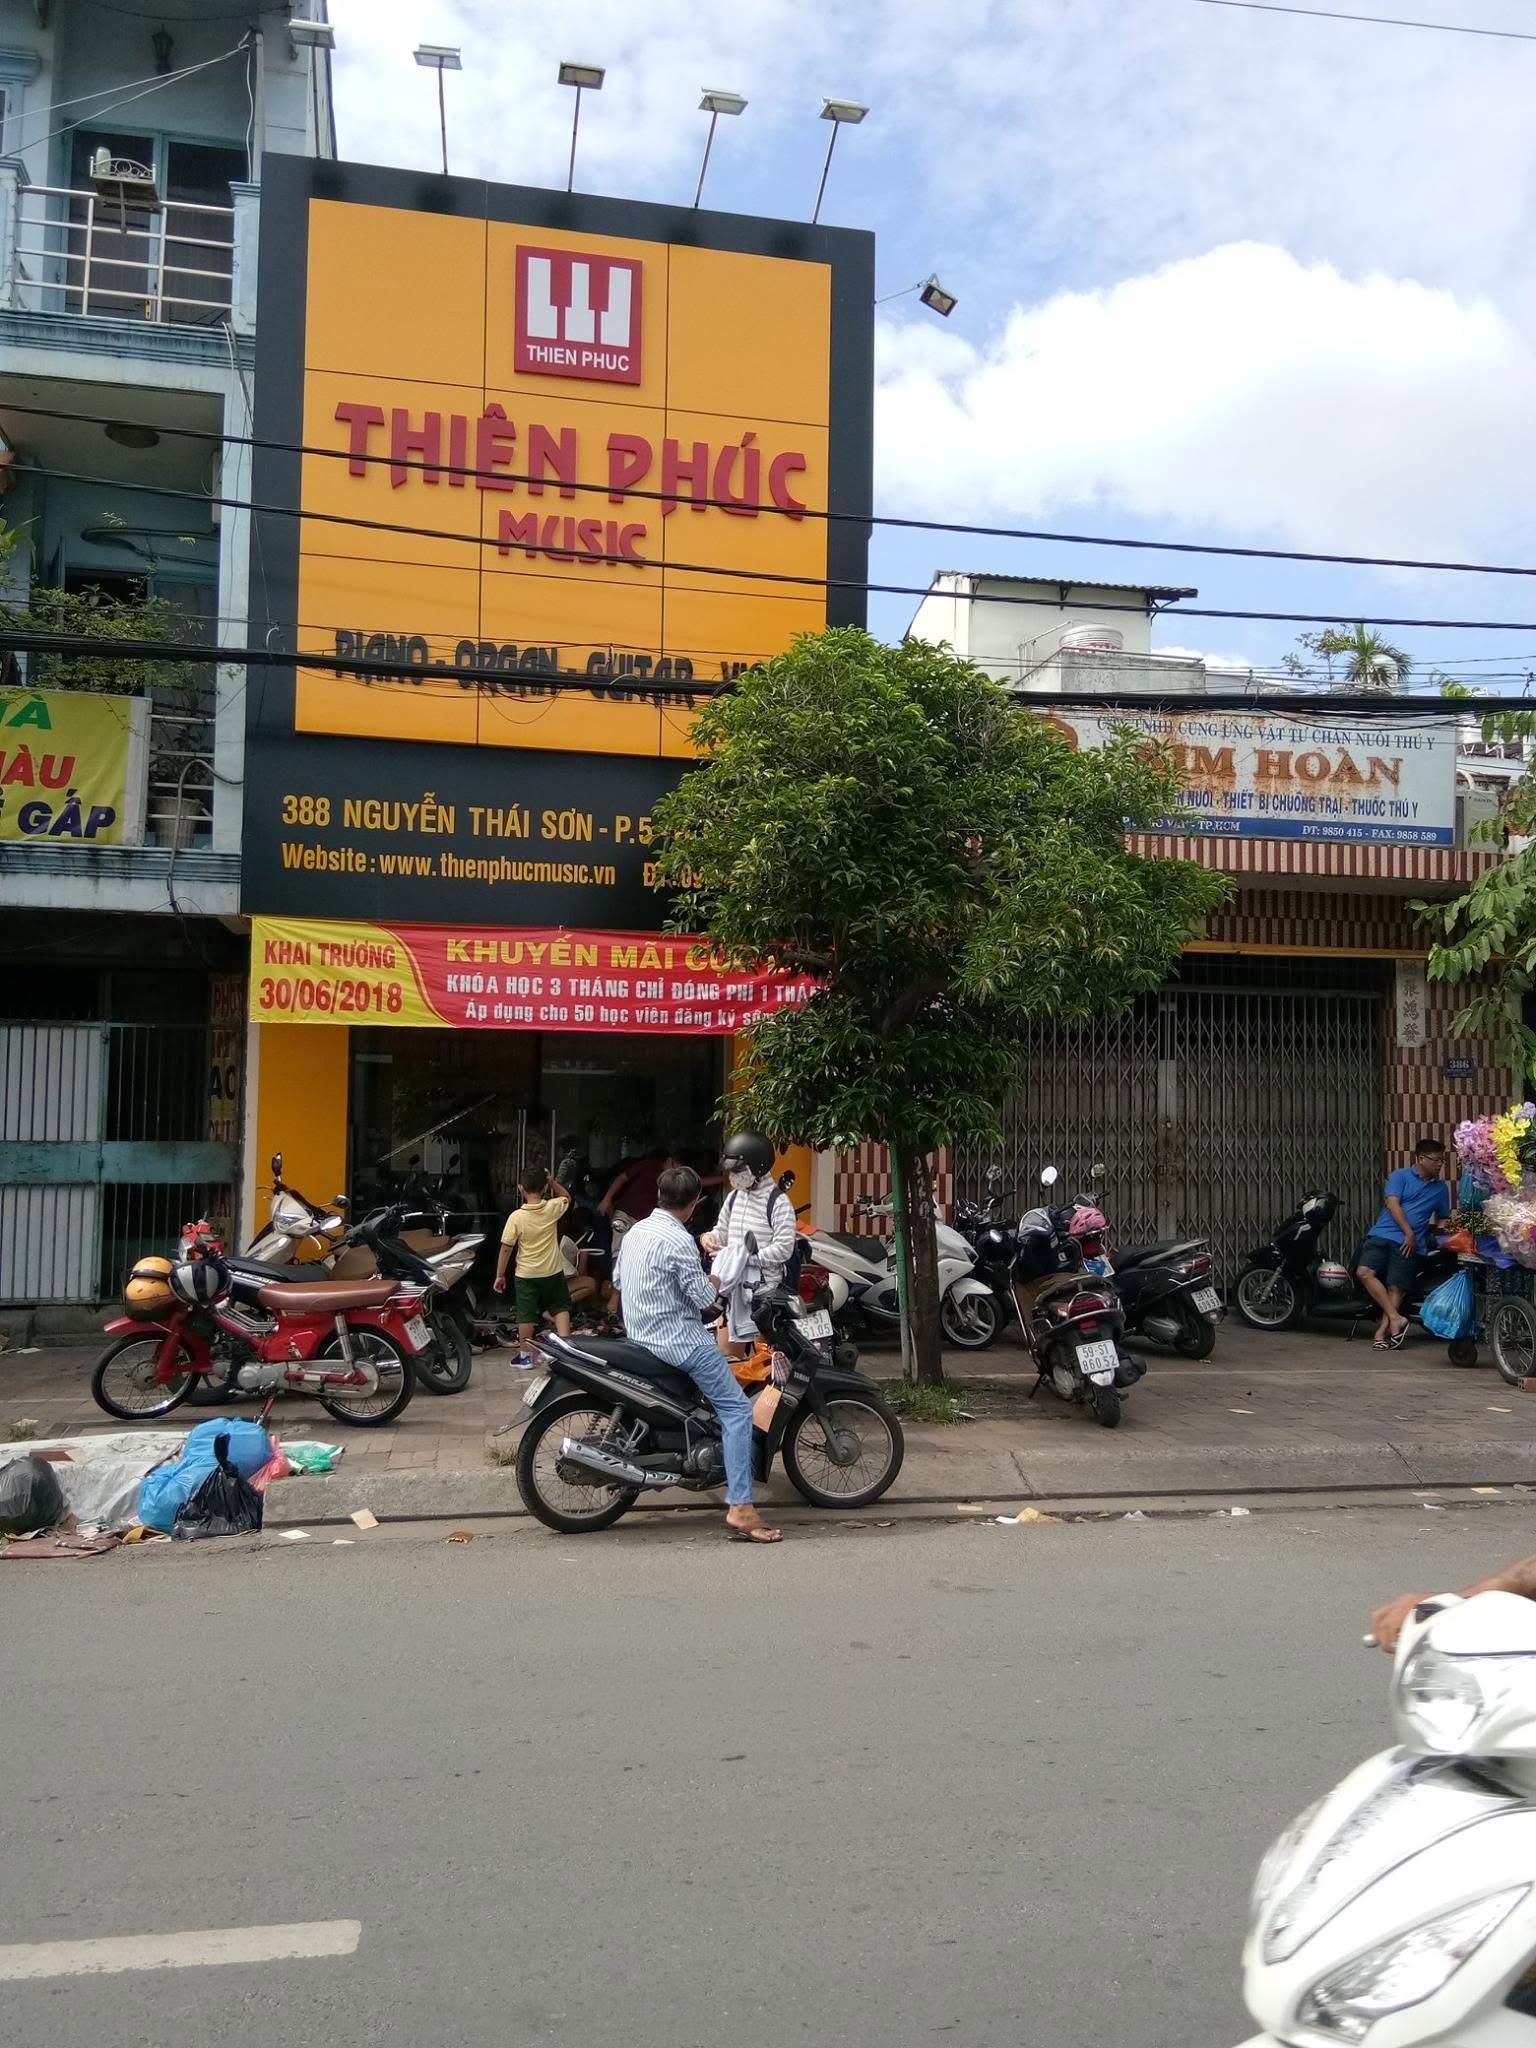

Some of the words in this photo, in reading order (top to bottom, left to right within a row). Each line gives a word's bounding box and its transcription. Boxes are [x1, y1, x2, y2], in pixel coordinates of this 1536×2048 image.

[526, 344, 577, 366] THIEN
[582, 350, 630, 372] PHUC
[334, 402, 577, 499] THIÊN
[606, 431, 807, 521] PHÚC
[498, 509, 648, 568] MUSIC
[1427, 737, 1436, 750] Y
[0, 744, 76, 790] ÀU
[18, 788, 116, 839] GẤP
[282, 795, 331, 827] 388
[343, 791, 456, 834] NGUYỄN
[468, 803, 530, 838] THÁI
[541, 807, 593, 842] SƠN
[615, 815, 653, 846] P.5
[1411, 802, 1418, 818] Y
[1322, 827, 1344, 837] 9850
[1346, 828, 1363, 837] 415
[1371, 829, 1395, 839] FAX:
[1396, 830, 1418, 840] 9858
[1420, 831, 1437, 841] 589
[264, 940, 311, 966] KHAI
[318, 939, 396, 969] TRƯƠNG
[446, 934, 598, 967] KHUYẾN
[610, 941, 673, 970] MÃI
[259, 977, 402, 1014] 30/06/2018
[446, 971, 499, 994] KHÓA
[506, 976, 543, 999] HỌC
[550, 977, 561, 996] 3
[569, 976, 629, 999] THÁNG
[635, 976, 664, 1000] CHỈ
[671, 978, 720, 1001] ĐÓNG
[726, 979, 753, 1002] PHÍ
[761, 985, 768, 1002] 1
[465, 998, 488, 1021] Áp
[493, 1001, 534, 1023] dụng
[539, 1003, 568, 1021] cho
[574, 1004, 594, 1022] 50
[600, 1005, 629, 1025] học
[635, 1006, 668, 1024] viên
[674, 1007, 712, 1028] đăng
[718, 1008, 736, 1028] ký
[1082, 1343, 1110, 1359] 59-S1
[1082, 1354, 1117, 1371] 860.52
